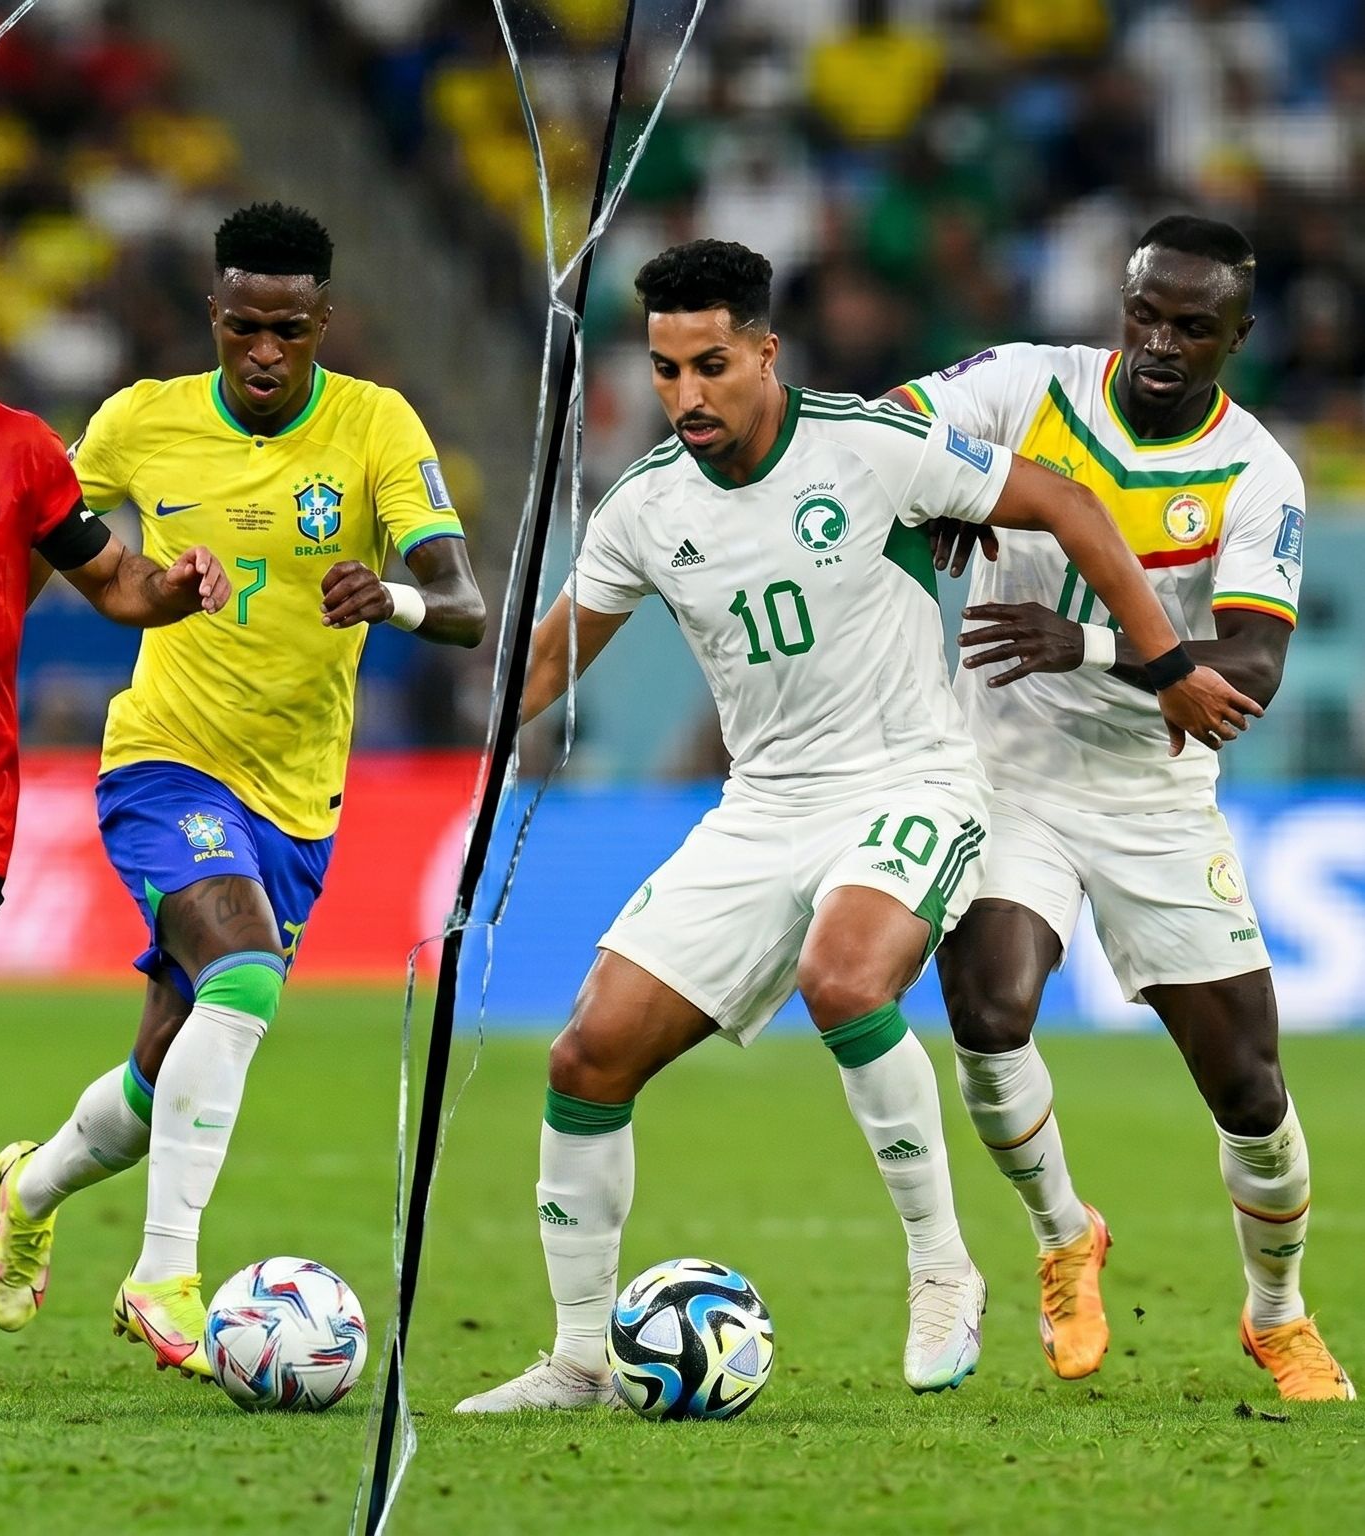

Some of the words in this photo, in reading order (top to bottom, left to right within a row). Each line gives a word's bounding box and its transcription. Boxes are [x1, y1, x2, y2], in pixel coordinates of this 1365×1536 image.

[295, 543, 342, 556] BRASIL
[236, 556, 267, 625] 7
[728, 579, 816, 665] 10
[857, 812, 939, 866] 10
